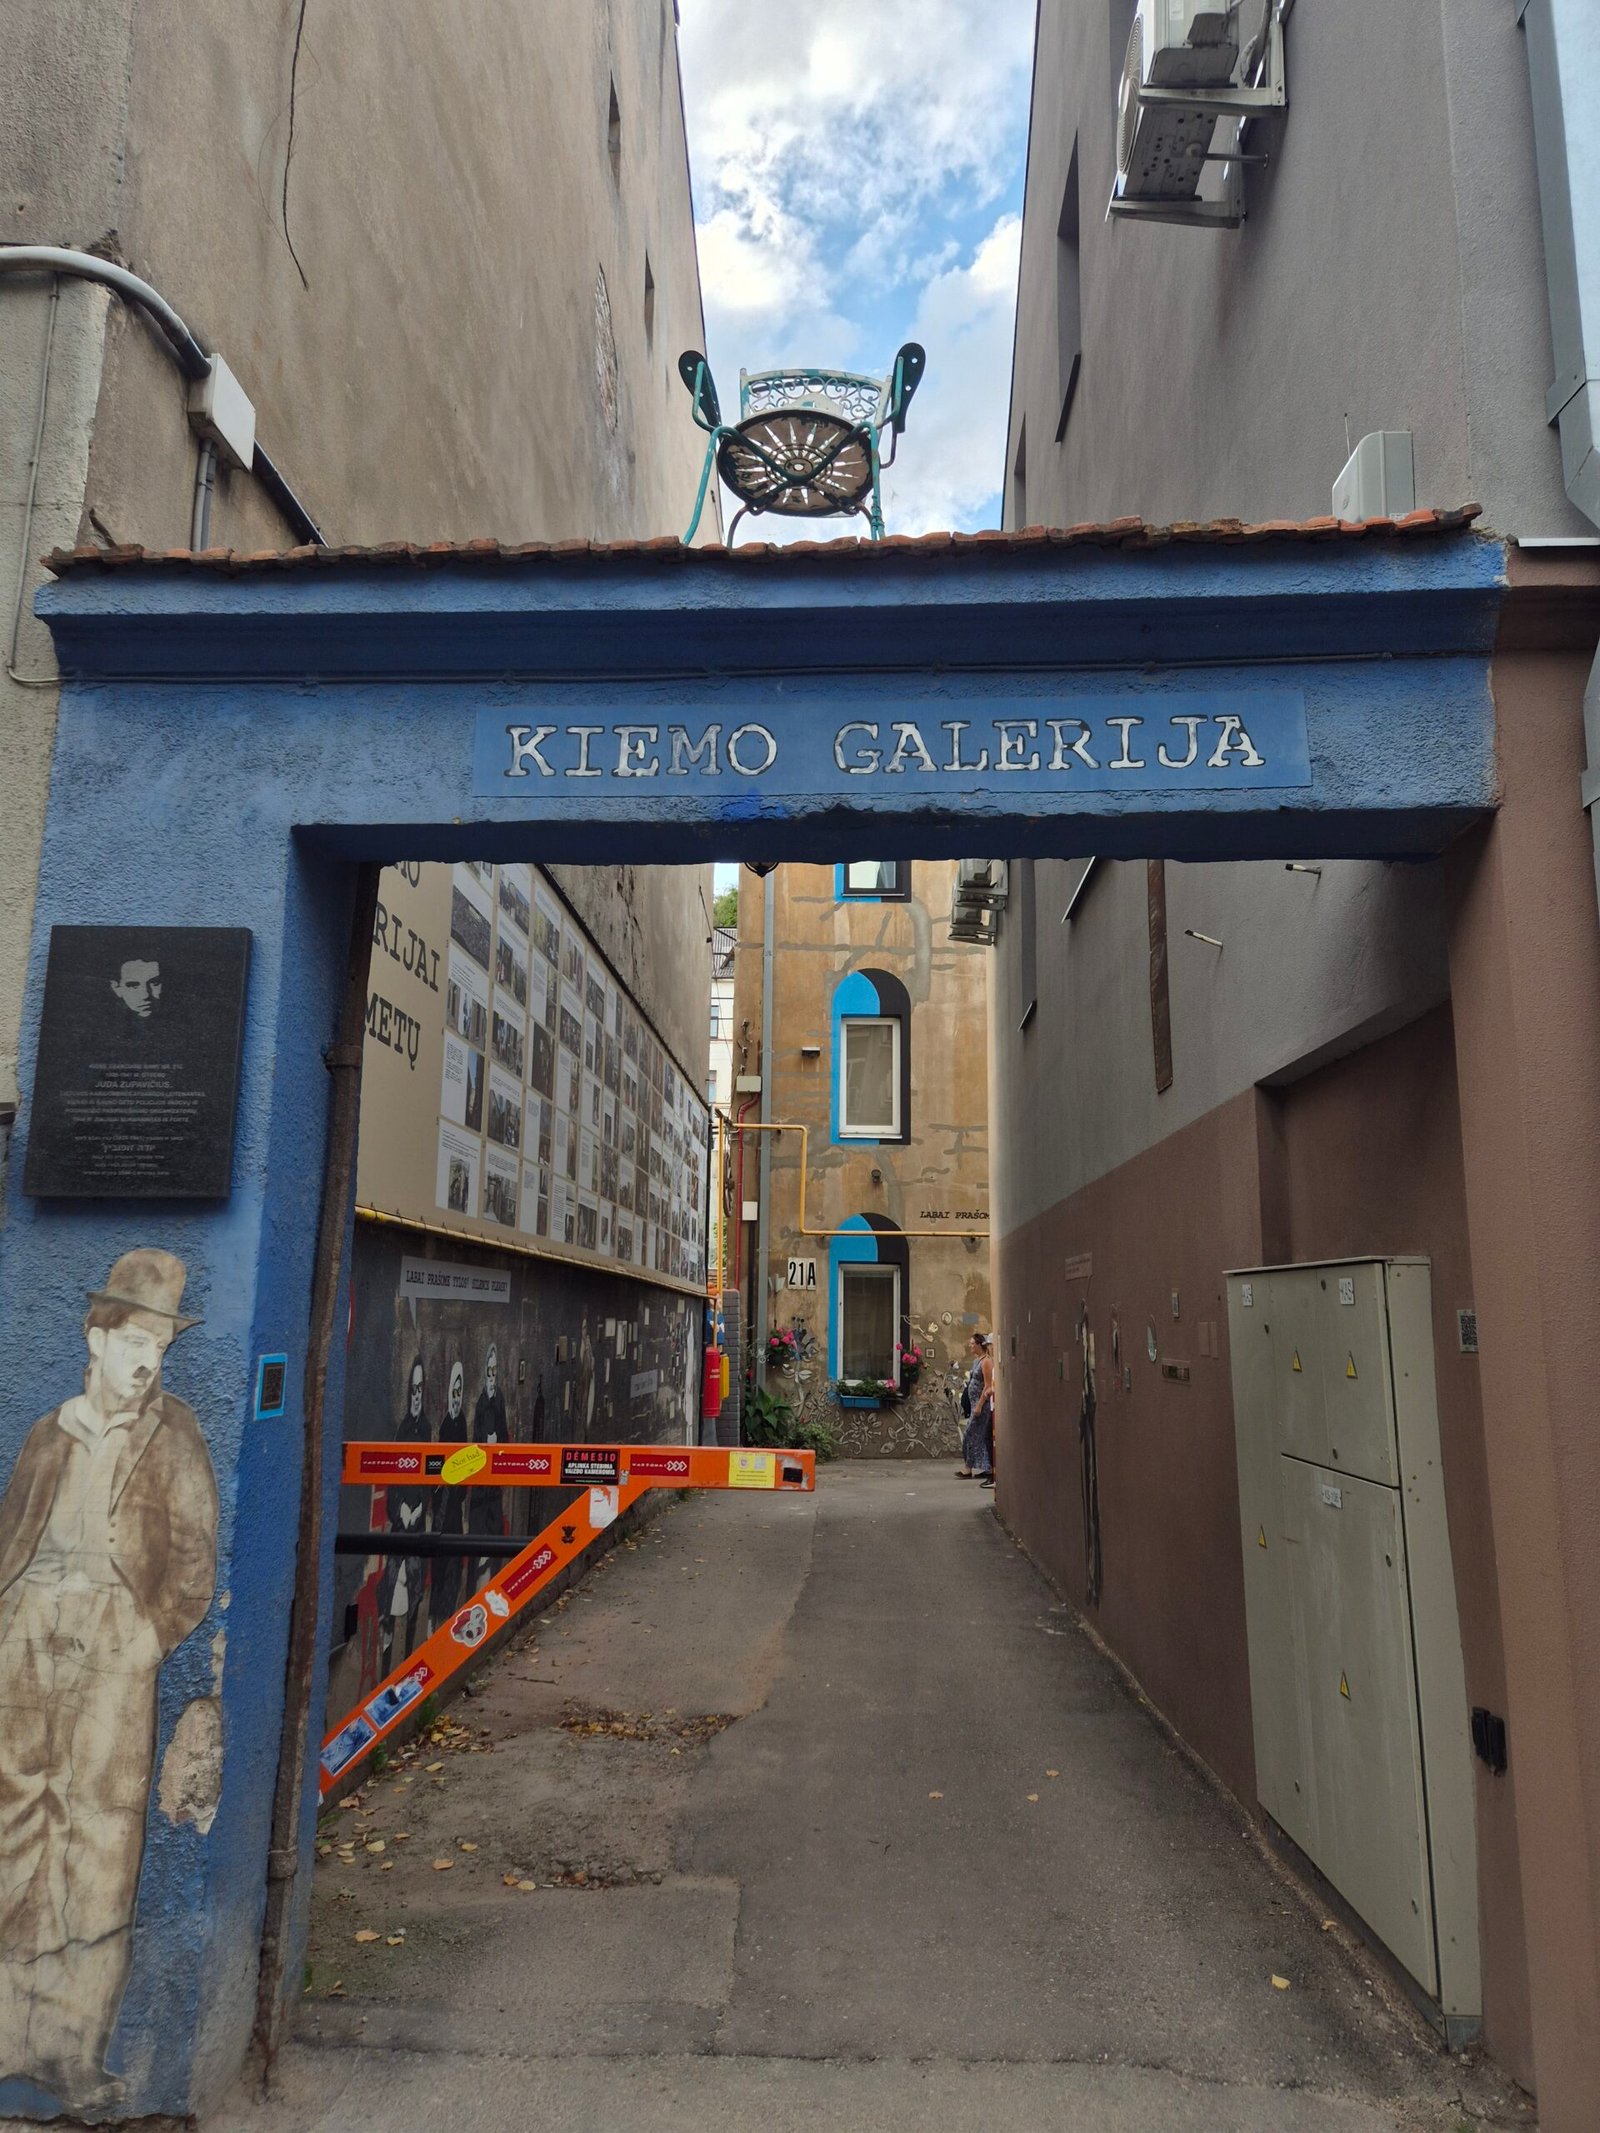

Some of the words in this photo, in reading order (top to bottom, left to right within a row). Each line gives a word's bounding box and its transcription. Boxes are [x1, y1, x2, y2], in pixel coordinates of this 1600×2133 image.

[505, 721, 777, 779] KIEMO
[833, 714, 1266, 776] GALERIJA
[919, 1210, 950, 1219] LABAI
[405, 1270, 425, 1285] LABAI
[788, 1261, 816, 1286] 21A
[565, 1450, 616, 1462] DĖMESIO
